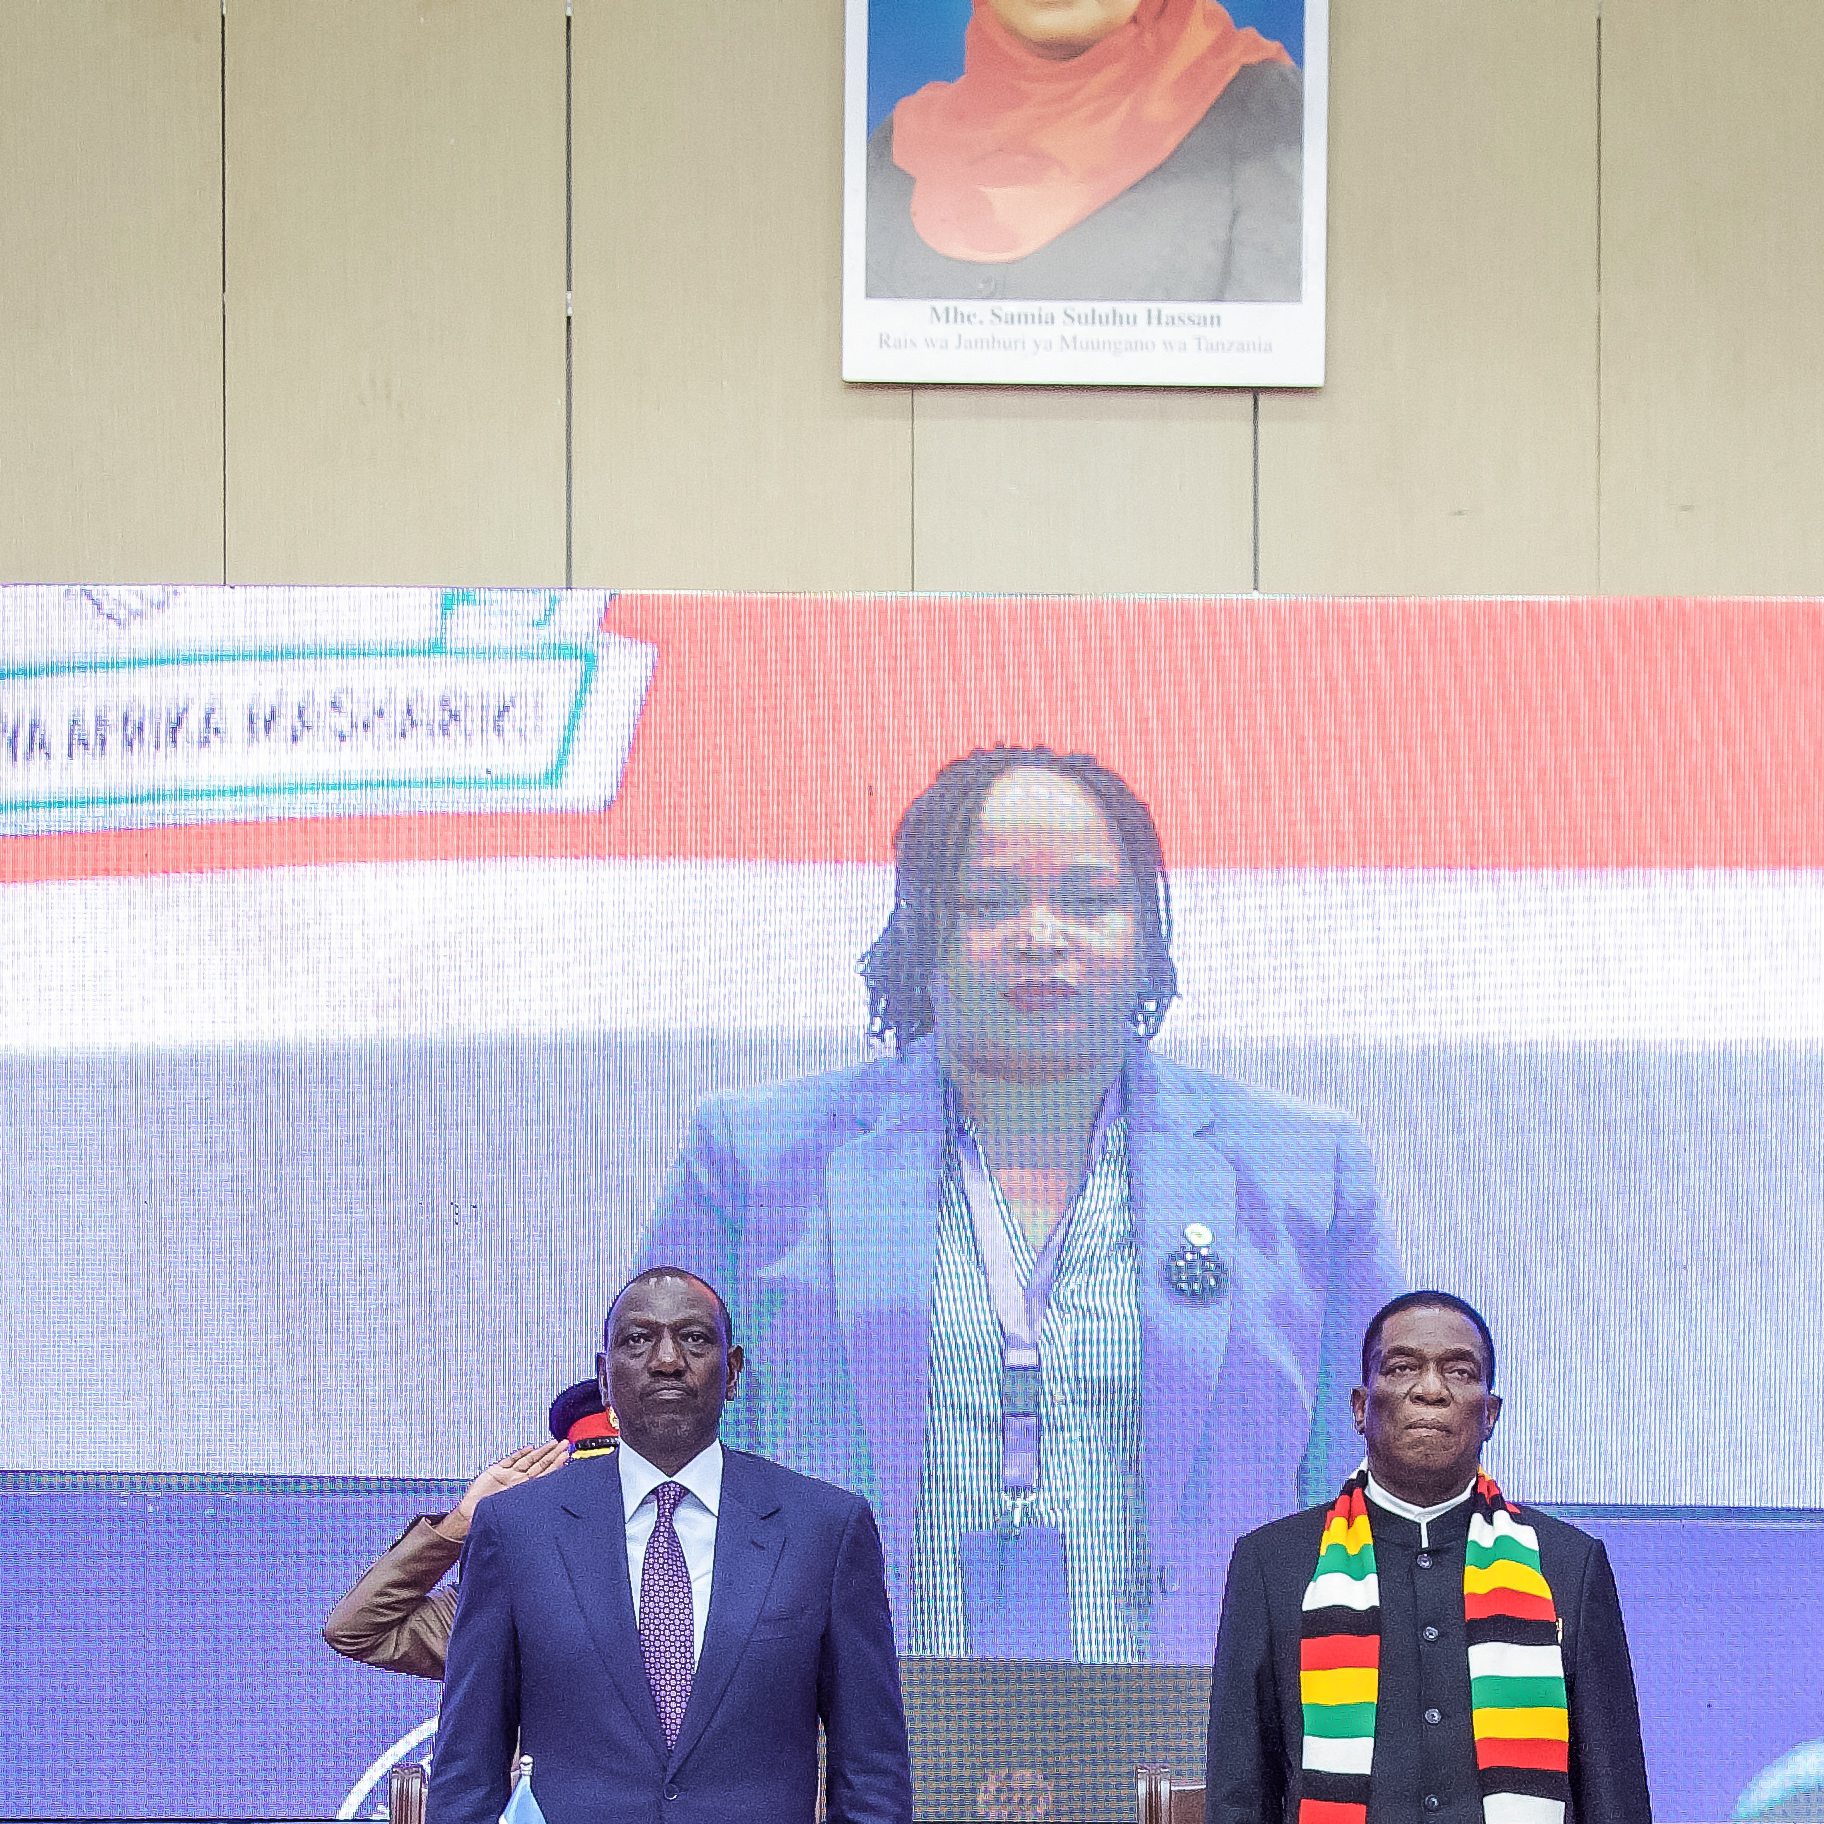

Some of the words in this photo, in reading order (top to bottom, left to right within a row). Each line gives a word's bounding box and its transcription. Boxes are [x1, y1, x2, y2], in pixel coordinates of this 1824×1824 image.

[989, 304, 1056, 326] Samia
[1063, 304, 1139, 327] Suluhu
[1146, 305, 1222, 328] Hassan
[1192, 333, 1273, 354] Tanzania
